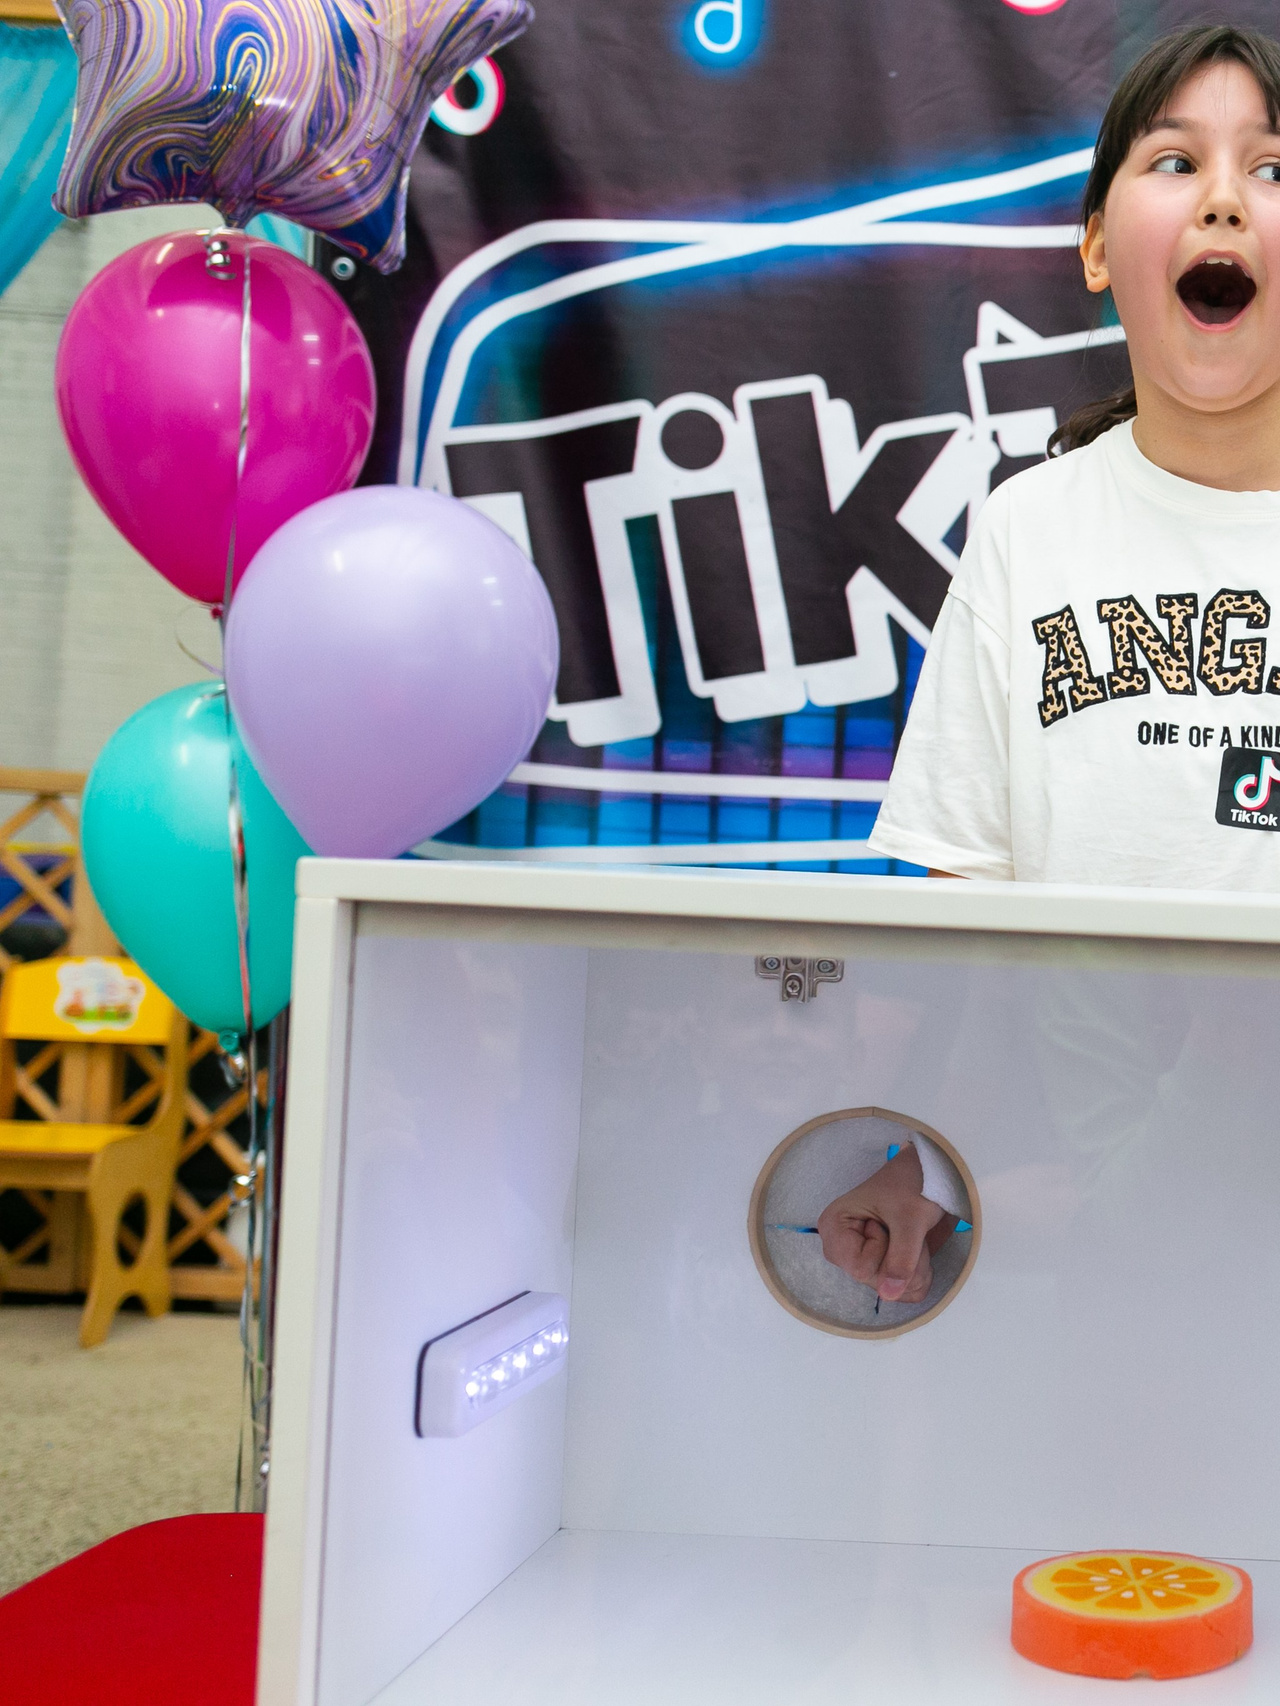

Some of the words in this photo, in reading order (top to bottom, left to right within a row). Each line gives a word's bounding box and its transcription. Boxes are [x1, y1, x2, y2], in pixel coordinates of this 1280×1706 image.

[1137, 720, 1180, 746] ONE
[1188, 725, 1215, 748] OF
[1219, 725, 1233, 748] A
[1230, 808, 1279, 827] TikTok
